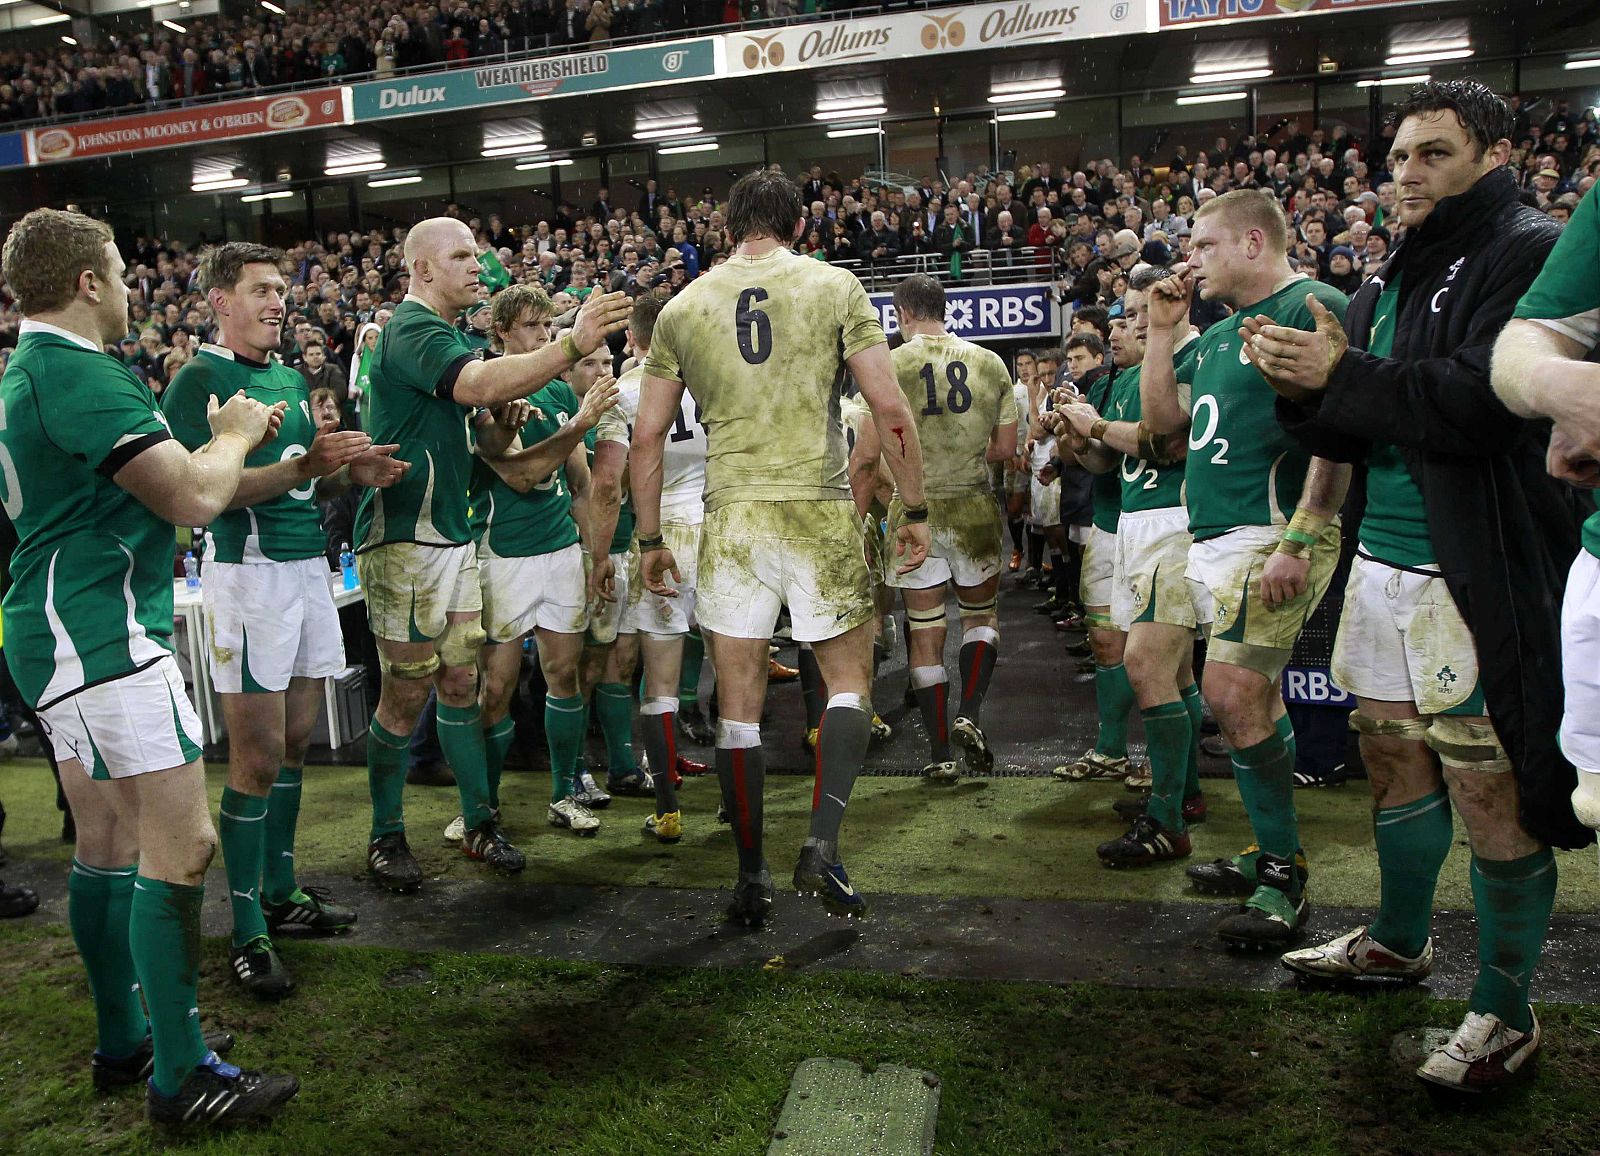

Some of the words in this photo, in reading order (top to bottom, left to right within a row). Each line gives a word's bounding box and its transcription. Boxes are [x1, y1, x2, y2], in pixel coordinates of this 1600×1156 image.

[980, 3, 1080, 42] Odlums
[798, 24, 892, 62] Odlums
[475, 54, 608, 88] WEATHERSHIELD
[379, 85, 447, 109] Dulux
[77, 129, 141, 150] JOHNSTON
[144, 120, 198, 138] MOONEY
[200, 119, 211, 131] &
[213, 111, 264, 129] O'BRIEN
[736, 287, 772, 364] 6
[979, 295, 1044, 328] RBS
[920, 361, 972, 415] 18
